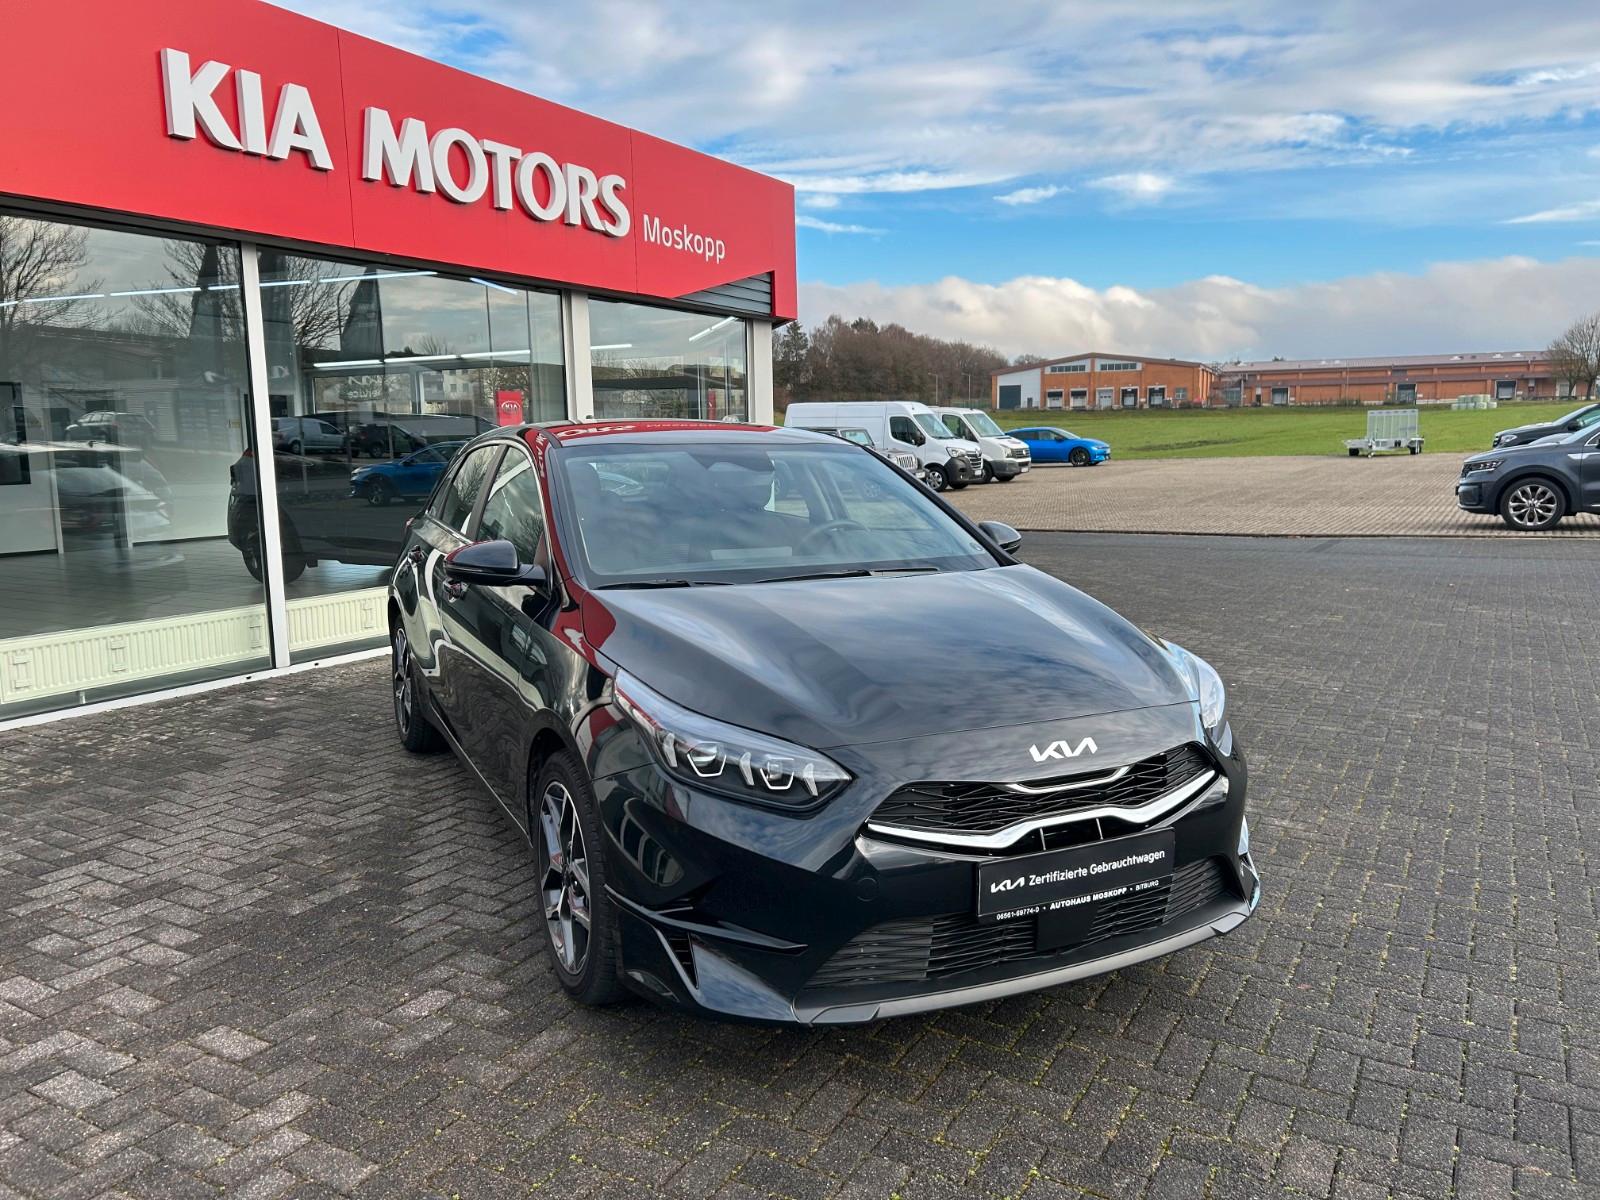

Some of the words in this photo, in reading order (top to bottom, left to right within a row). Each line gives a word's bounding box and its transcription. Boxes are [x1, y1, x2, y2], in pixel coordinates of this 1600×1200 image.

[160, 48, 334, 171] KIA
[362, 106, 631, 237] MOTORS
[643, 213, 725, 264] Moskopp
[1029, 736, 1098, 762] KIA
[990, 876, 1025, 893] KIA
[1029, 866, 1088, 886] Zertifizierte
[1089, 850, 1166, 875] Gebrauchtwagen
[1050, 895, 1091, 910] AUTOHAUS
[1092, 887, 1127, 901] MOSKOPP
[1135, 879, 1159, 891] BITBURG
